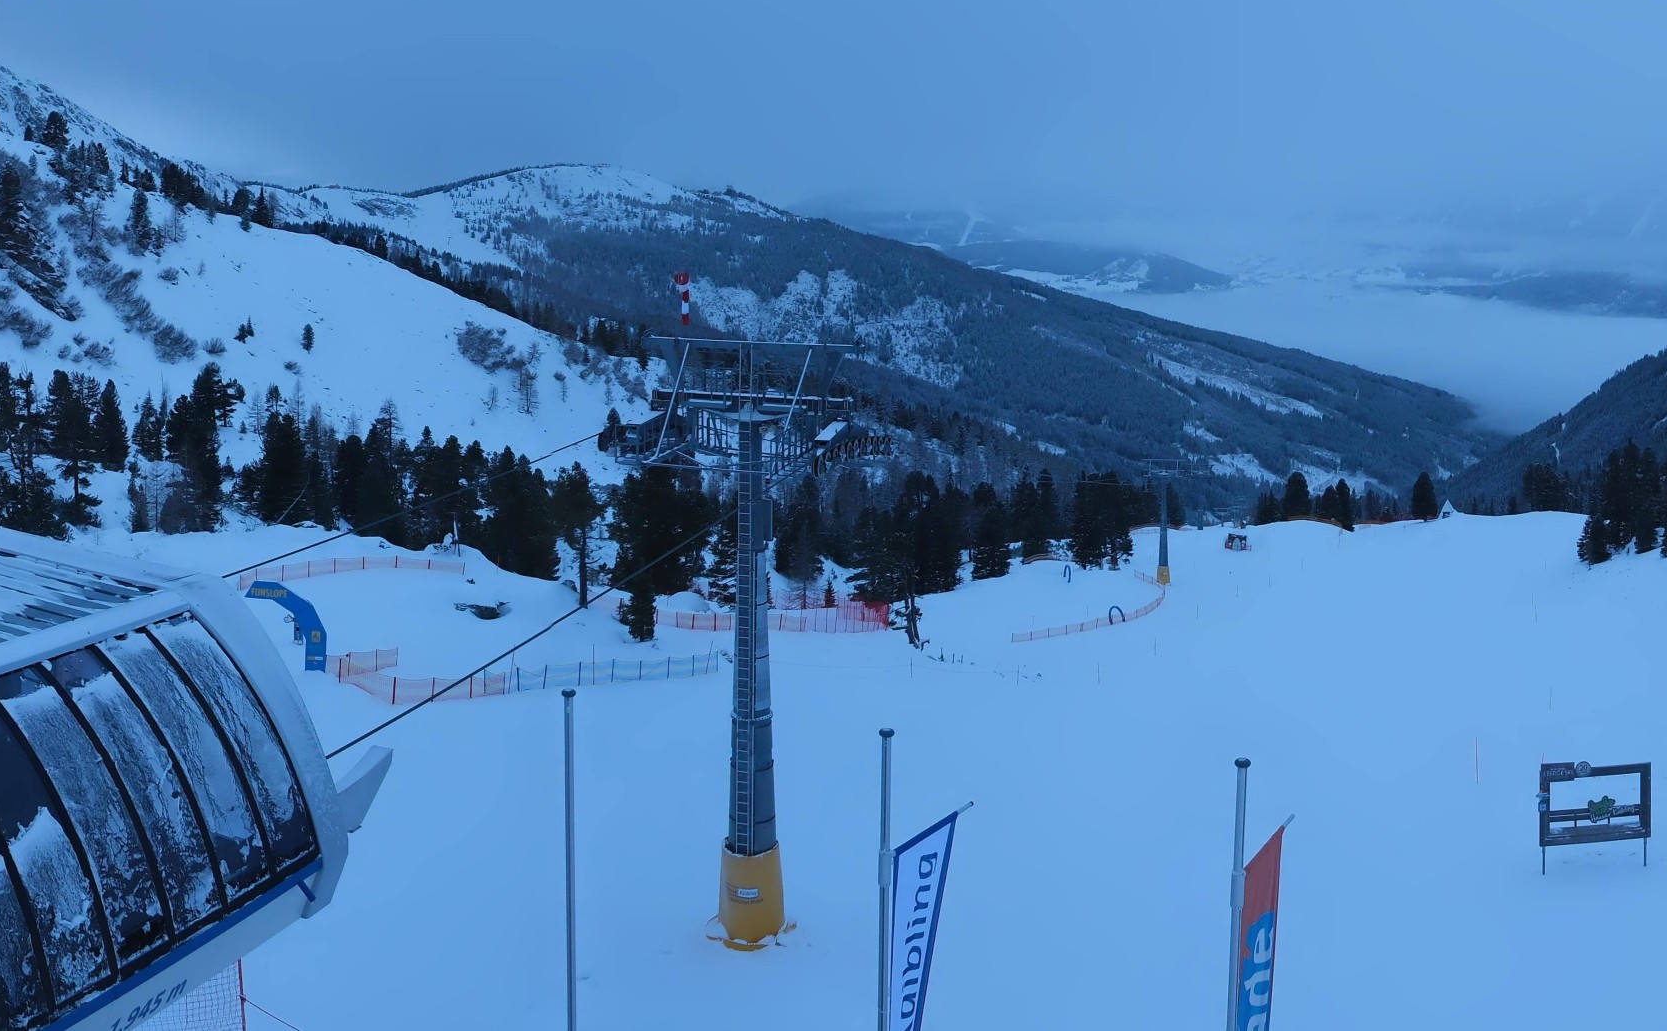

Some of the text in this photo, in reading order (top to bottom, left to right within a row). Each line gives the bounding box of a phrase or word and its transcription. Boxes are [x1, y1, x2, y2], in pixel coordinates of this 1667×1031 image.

[251, 588, 288, 599] FUNSLOPE
[901, 852, 938, 1031] aibling
[166, 979, 188, 1003] m
